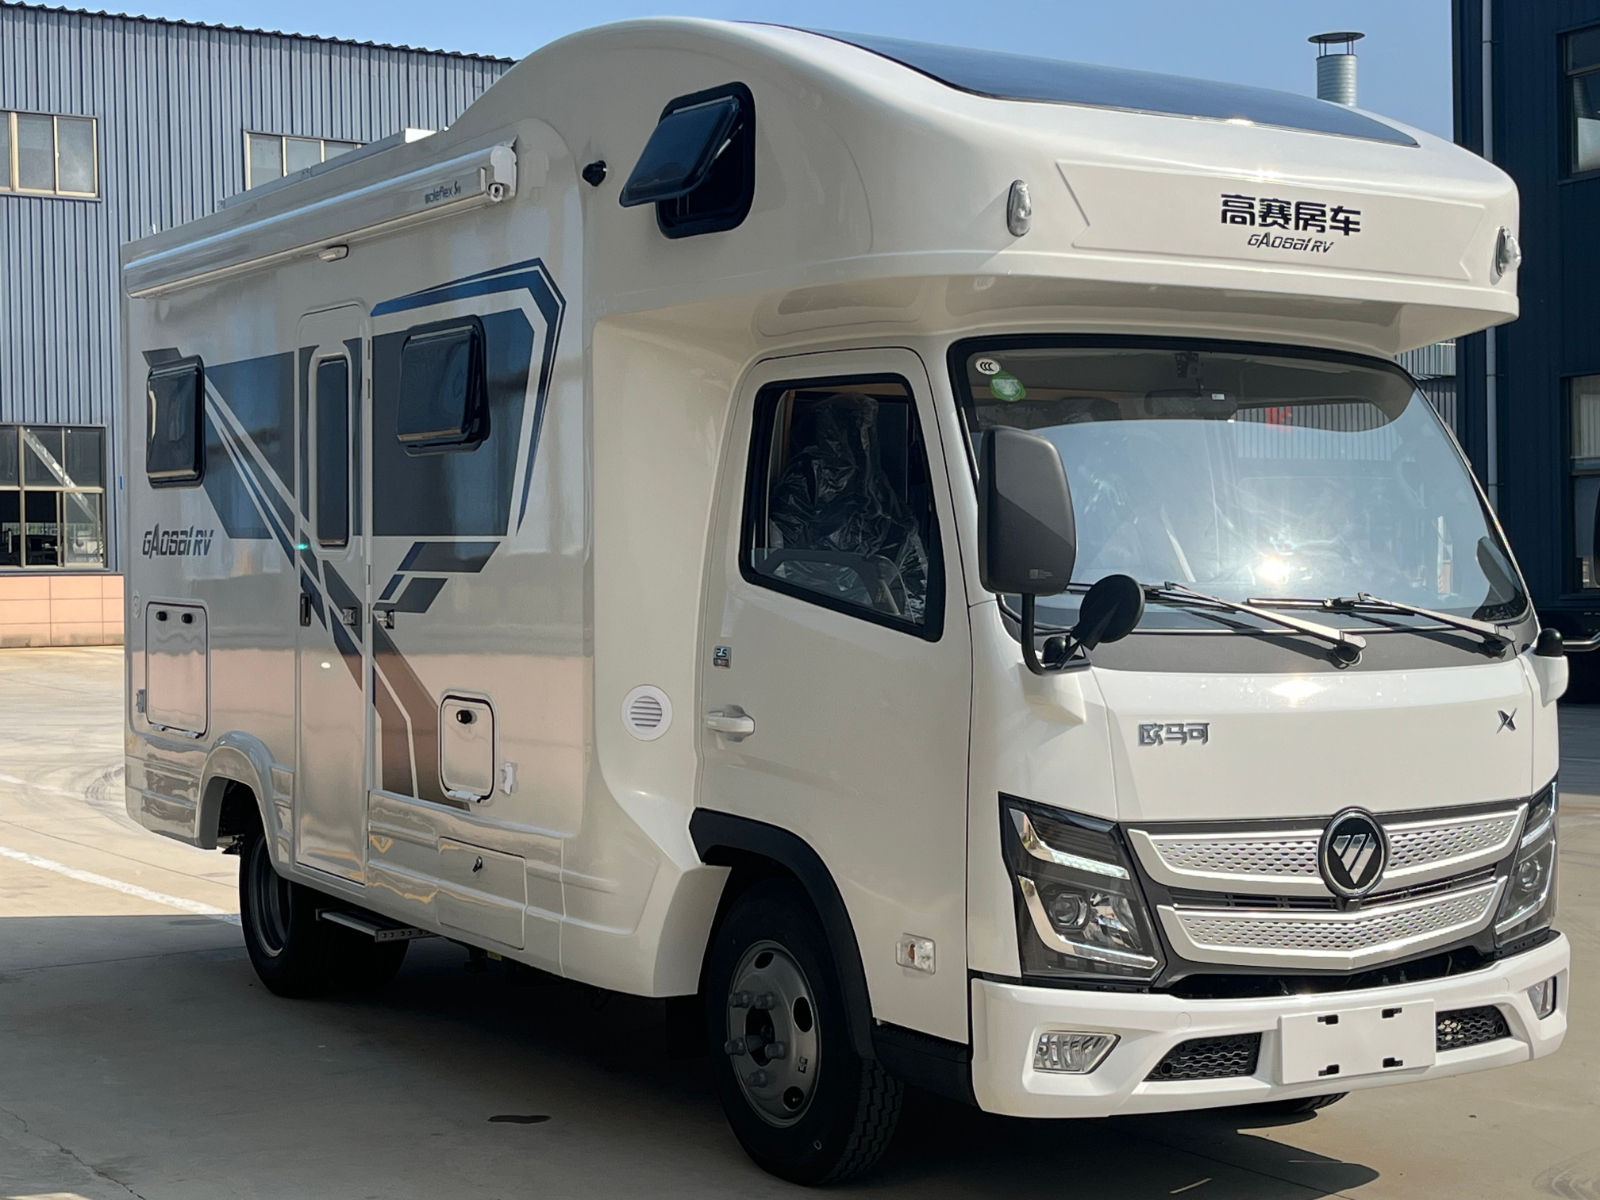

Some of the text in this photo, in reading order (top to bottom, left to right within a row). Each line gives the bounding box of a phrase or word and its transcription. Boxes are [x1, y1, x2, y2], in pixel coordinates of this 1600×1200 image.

[1221, 193, 1361, 236] 高赛房车
[1310, 240, 1335, 253] RV
[193, 529, 214, 556] RV
[1138, 722, 1210, 746] 欧马可
